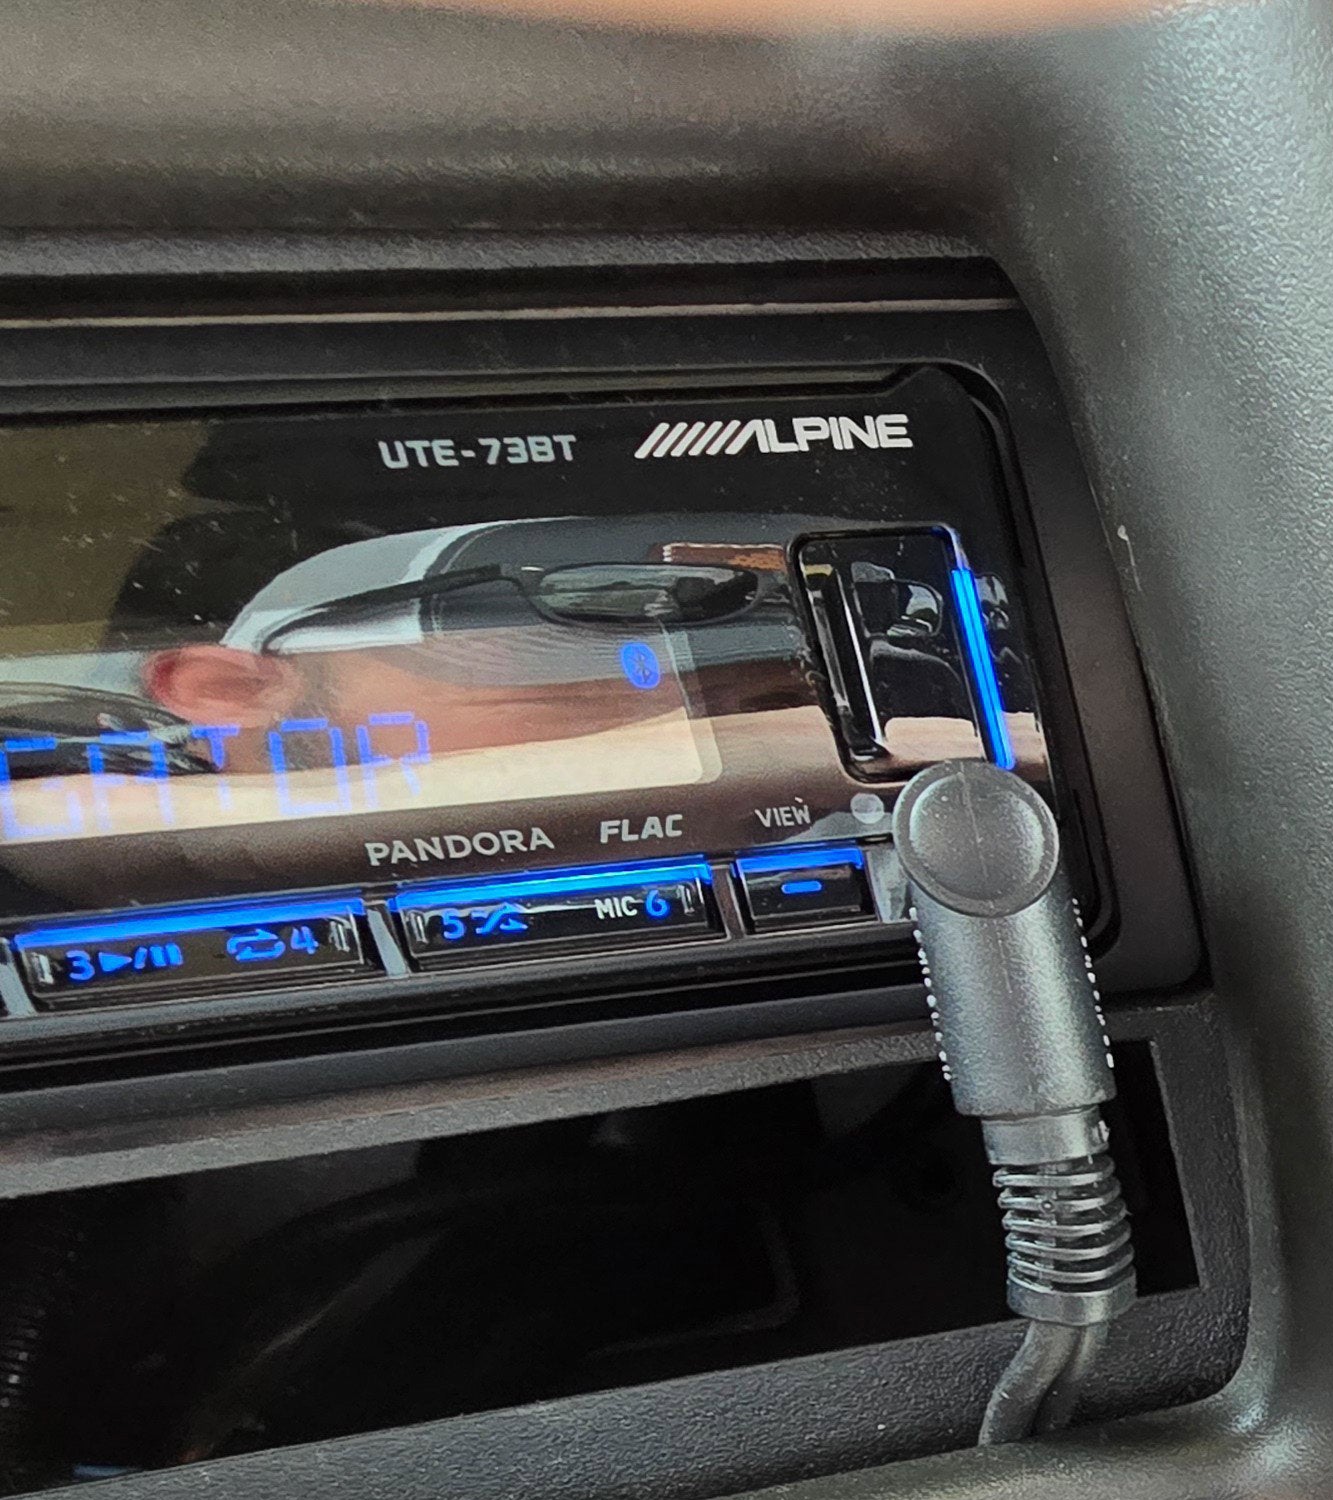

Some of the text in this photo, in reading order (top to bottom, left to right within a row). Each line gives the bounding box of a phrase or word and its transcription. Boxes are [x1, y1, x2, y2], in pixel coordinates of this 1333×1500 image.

[725, 413, 913, 454] ALPINE
[378, 434, 576, 469] UTE-73BT
[600, 813, 684, 843] FLAC
[754, 804, 811, 828] VIEW
[364, 827, 555, 867] PANDORA
[594, 888, 670, 920] MIC 6
[290, 925, 319, 956] 4
[441, 909, 467, 941] 5
[66, 951, 96, 983] 3
